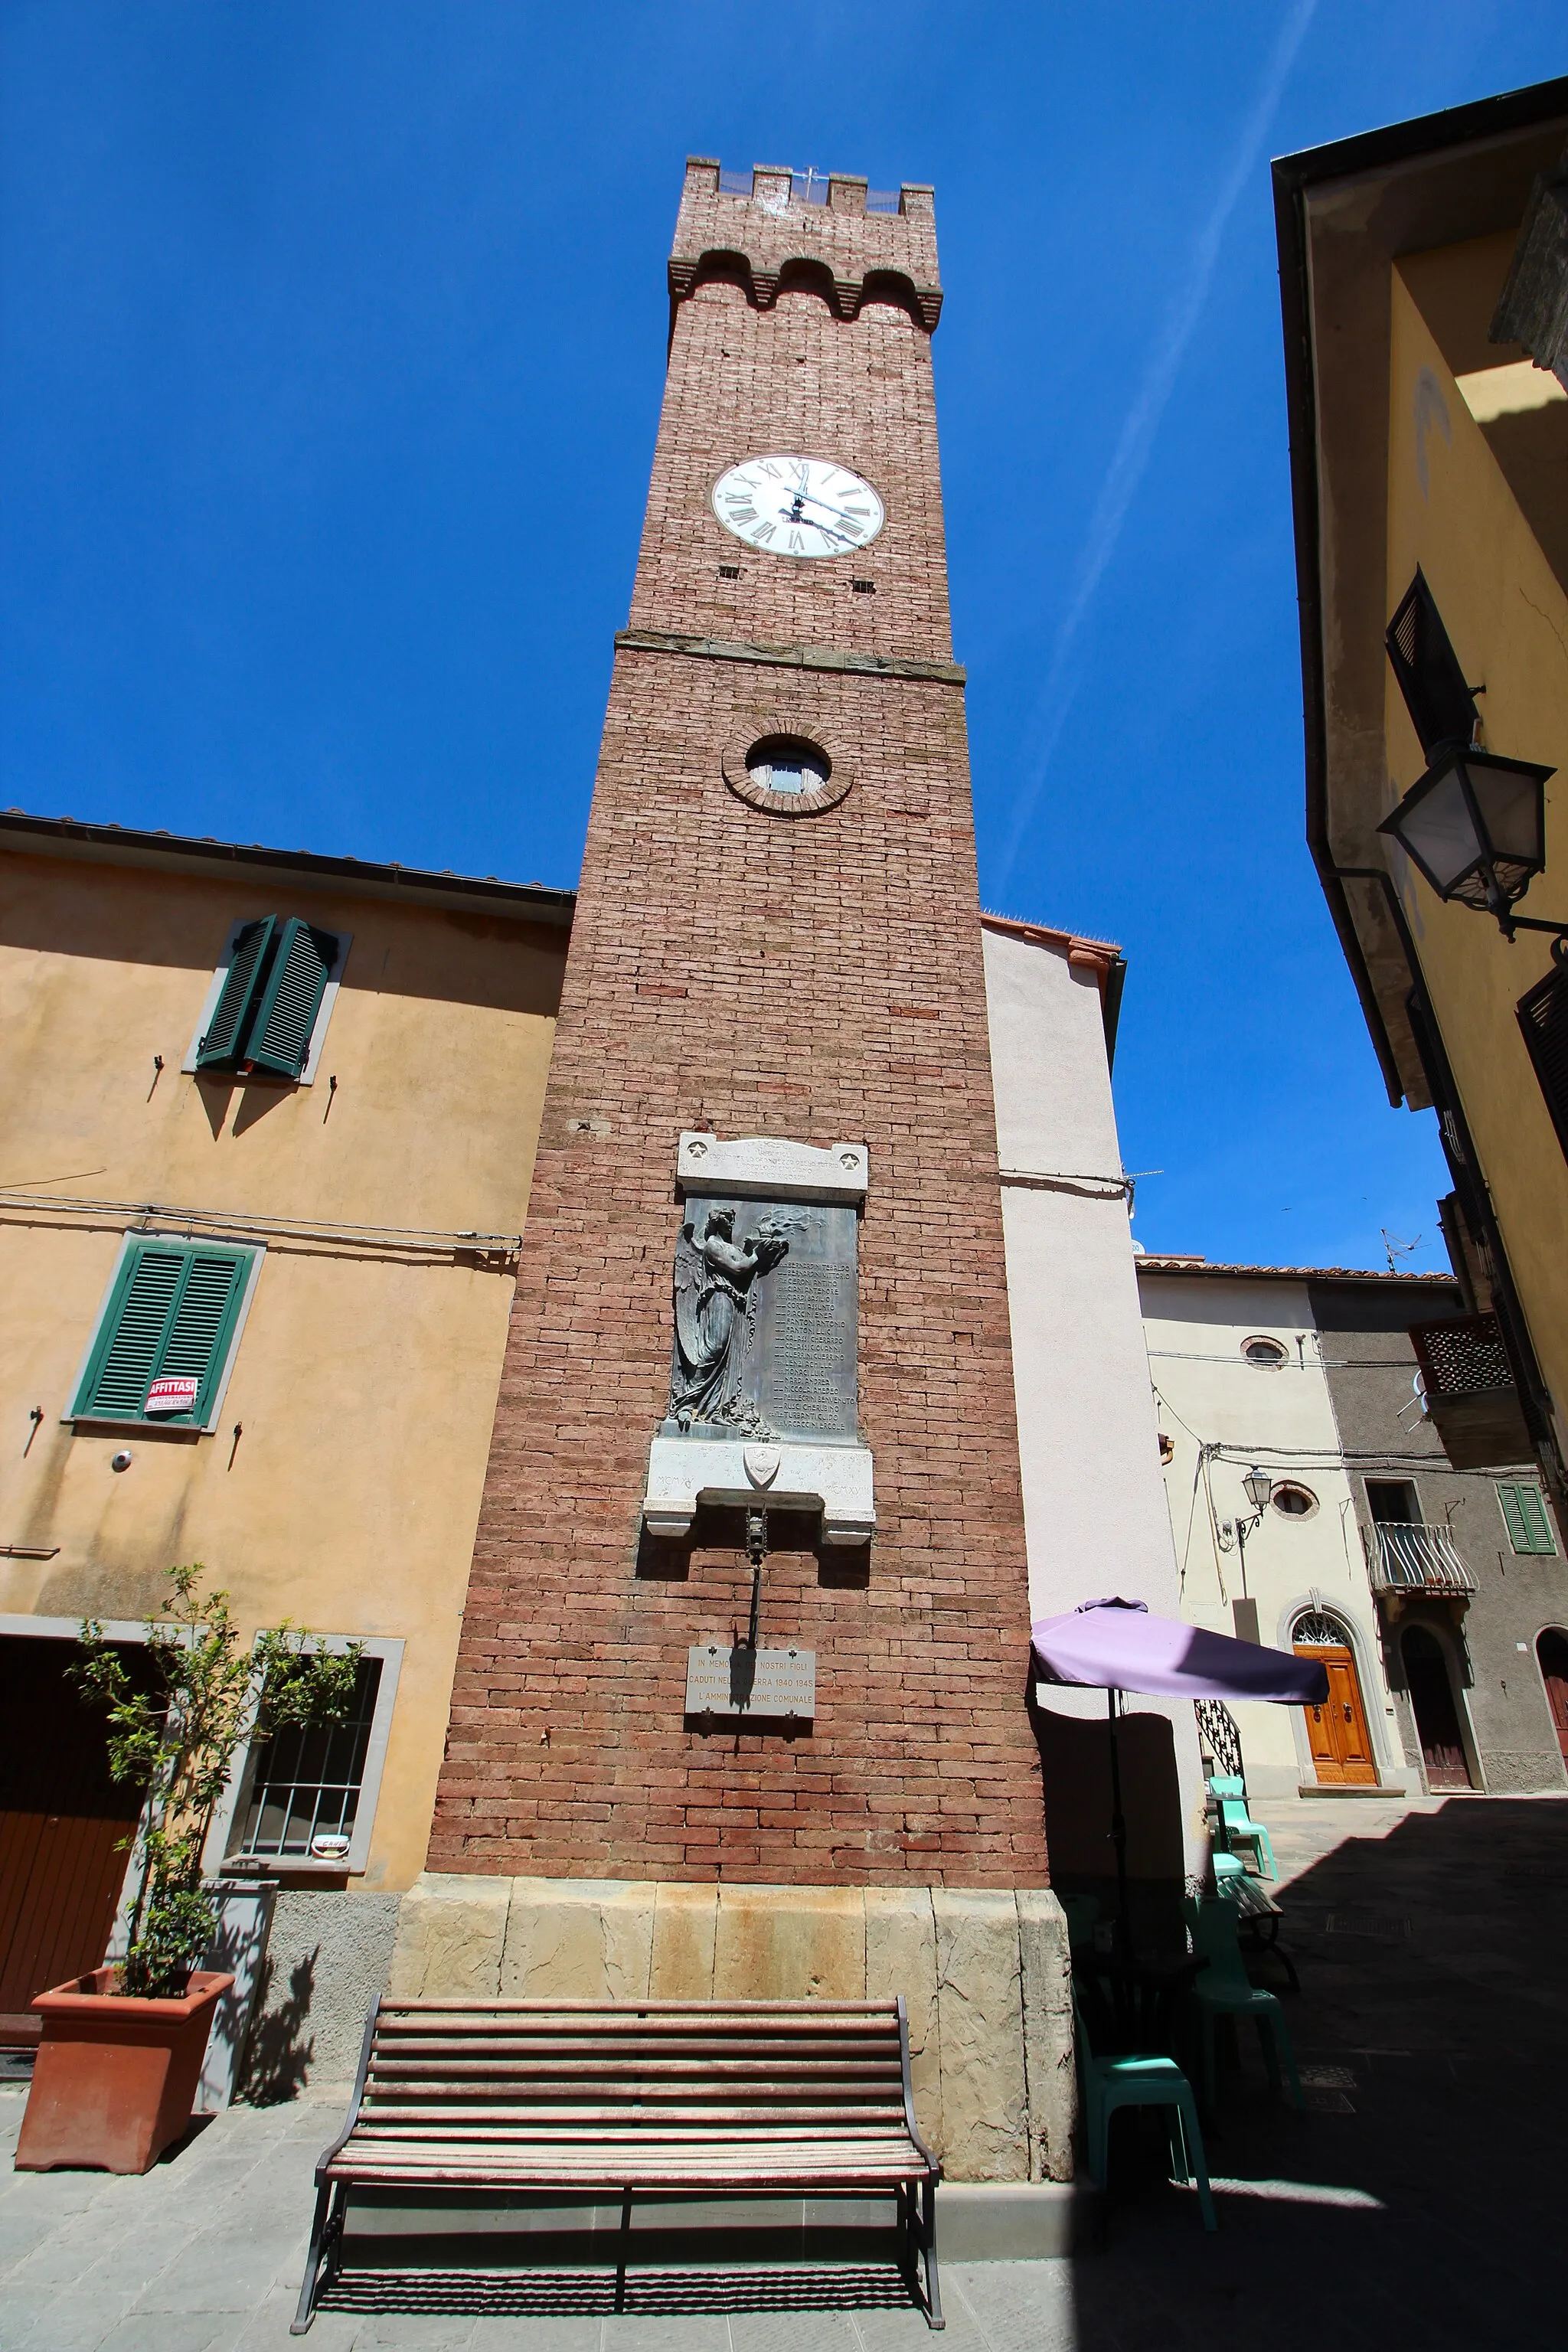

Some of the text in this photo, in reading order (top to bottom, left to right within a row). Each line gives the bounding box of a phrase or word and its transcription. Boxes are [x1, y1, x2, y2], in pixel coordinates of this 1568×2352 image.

[788, 1261, 821, 1270] BERNARDINI
[822, 1263, 850, 1272] TEBALDO
[787, 1269, 851, 1280] BERNARDINI VITTORIO
[787, 1278, 812, 1286] CERONI
[805, 1287, 840, 1295] ANTENORE
[786, 1302, 835, 1312] CORTI ASSUNTO
[786, 1318, 846, 1328] FANTONI ANTONIO
[786, 1326, 815, 1334] FANTONI
[805, 1361, 833, 1369] ACHILLE
[805, 1377, 830, 1386] ANDREA
[149, 1381, 194, 1395] AFFITTASI
[813, 1387, 839, 1395] AMEDEO
[818, 1395, 855, 1405] BENVENUTO
[802, 1403, 839, 1413] CHERUBINO
[783, 1410, 817, 1420] TURBANTI
[819, 1422, 845, 1431] ERCOLE
[689, 1675, 715, 1684] CADUTI
[776, 1678, 793, 1687] 1940
[773, 1695, 812, 1704] COMUNALE
